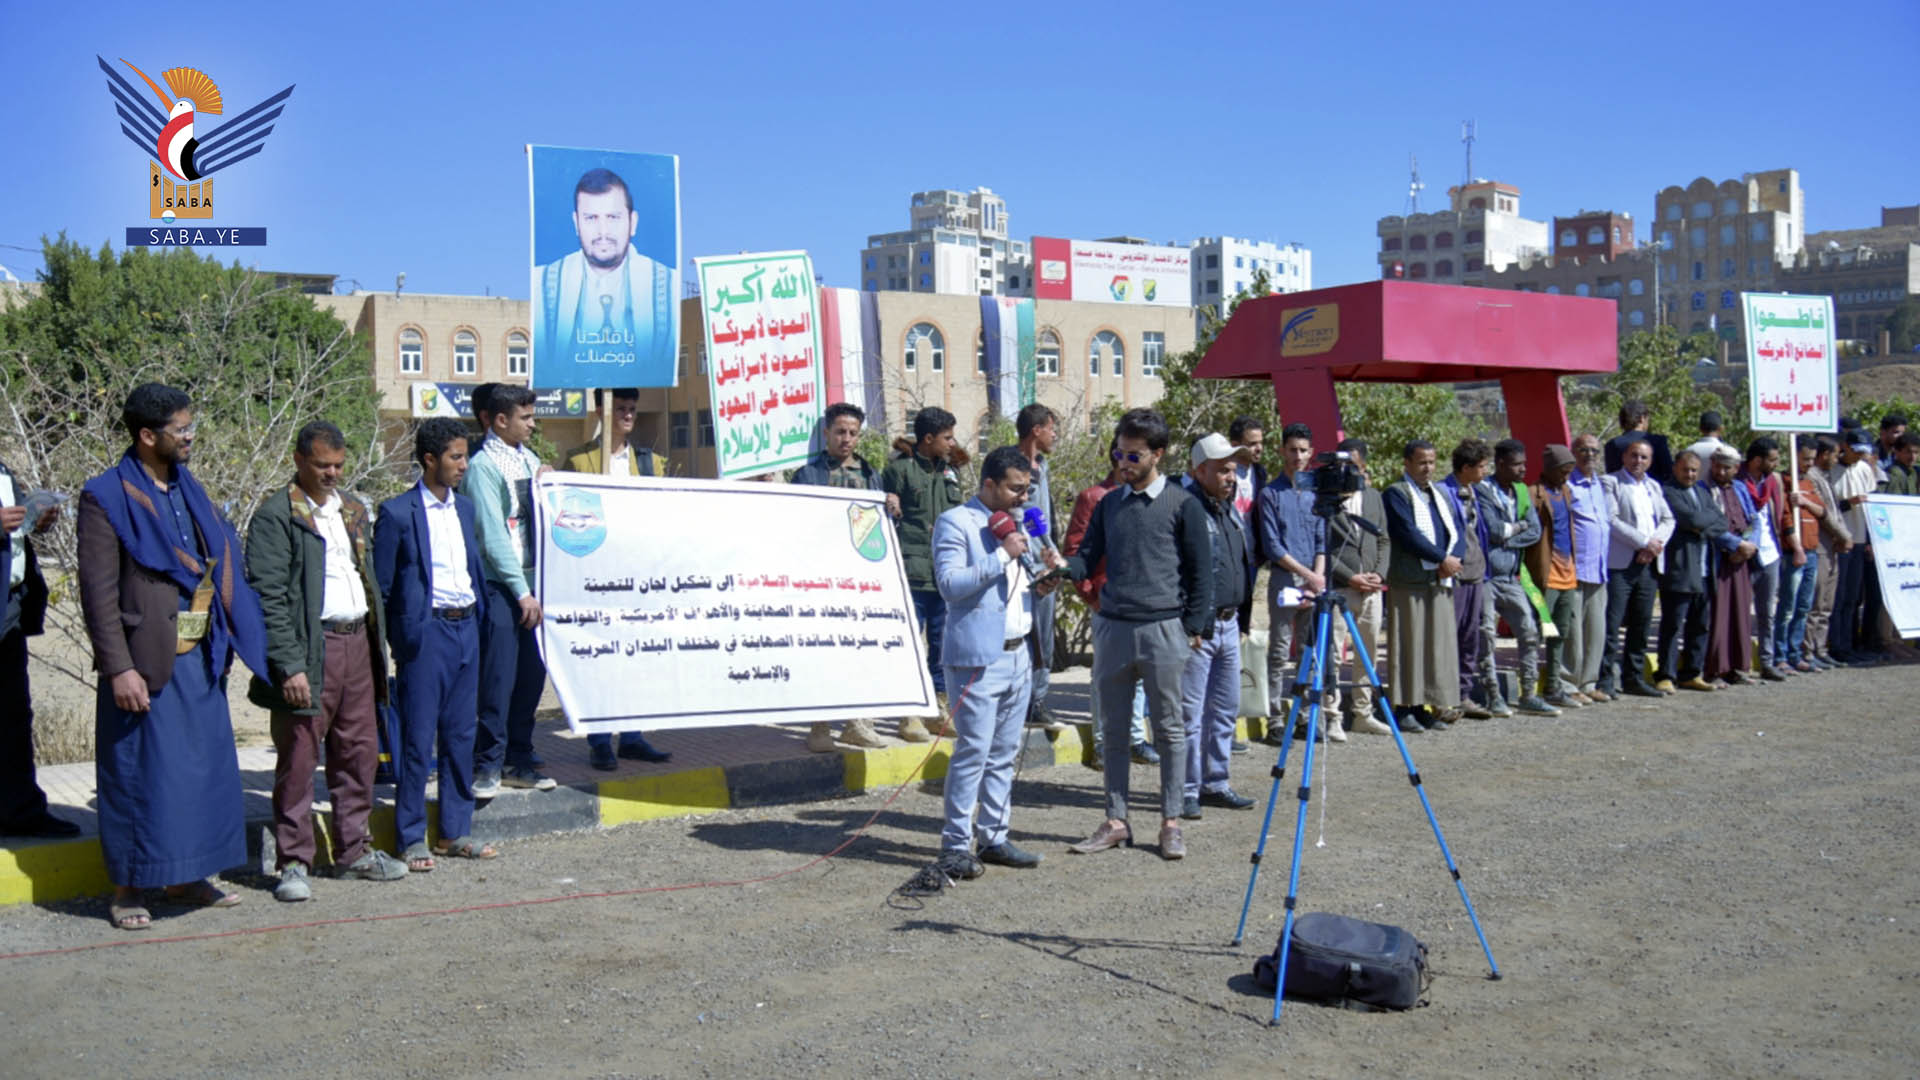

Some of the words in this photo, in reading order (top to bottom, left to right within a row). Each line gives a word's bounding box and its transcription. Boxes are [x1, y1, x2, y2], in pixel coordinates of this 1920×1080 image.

[710, 264, 766, 317] أكبر
[771, 265, 807, 300] الله
[768, 312, 810, 341] الموت
[624, 328, 635, 347] يا
[771, 347, 813, 376] الموت
[1789, 367, 1795, 384] و
[760, 388, 779, 416] على
[782, 381, 815, 405] اللعنة
[719, 391, 756, 422] اليهود
[775, 411, 815, 456] النصر
[639, 576, 666, 594] لجان
[671, 574, 712, 593] تشكيل
[716, 574, 735, 592] إلى
[792, 576, 833, 592] الشعوب
[858, 578, 882, 593] ندعو
[744, 603, 794, 621] الصهاينة
[798, 604, 815, 618] ضد
[820, 604, 858, 621] والجهاد
[570, 640, 620, 659] العربية
[625, 637, 673, 657] البلدان
[677, 636, 720, 651] مختلف
[725, 634, 738, 657] في
[741, 633, 794, 651] الصهاينة
[798, 633, 836, 647] لمساندة
[882, 635, 904, 653] التي
